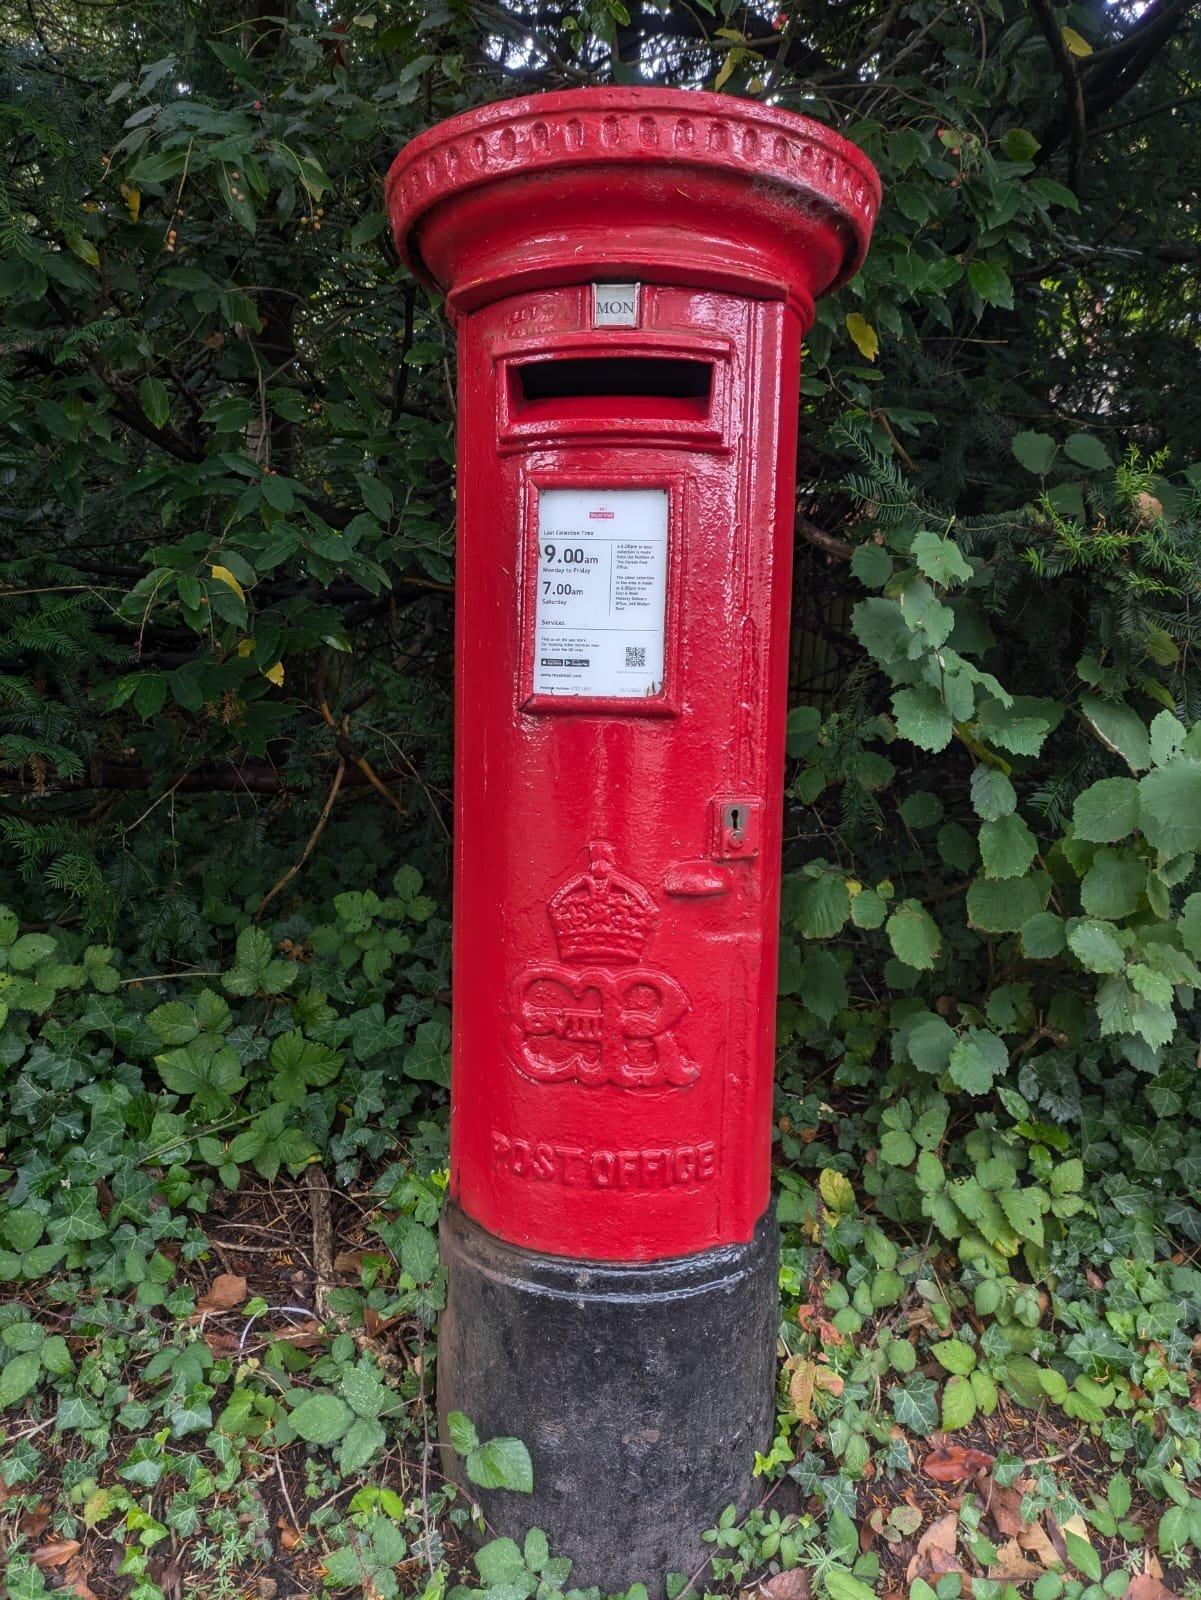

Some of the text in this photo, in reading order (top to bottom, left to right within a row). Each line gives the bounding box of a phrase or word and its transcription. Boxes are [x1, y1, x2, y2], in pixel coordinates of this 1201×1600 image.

[596, 301, 636, 314] MON
[544, 544, 598, 564] 9.00am
[542, 581, 584, 596] 7.00am
[542, 598, 567, 606] Saturday
[490, 1128, 716, 1188] POST OFFICE
